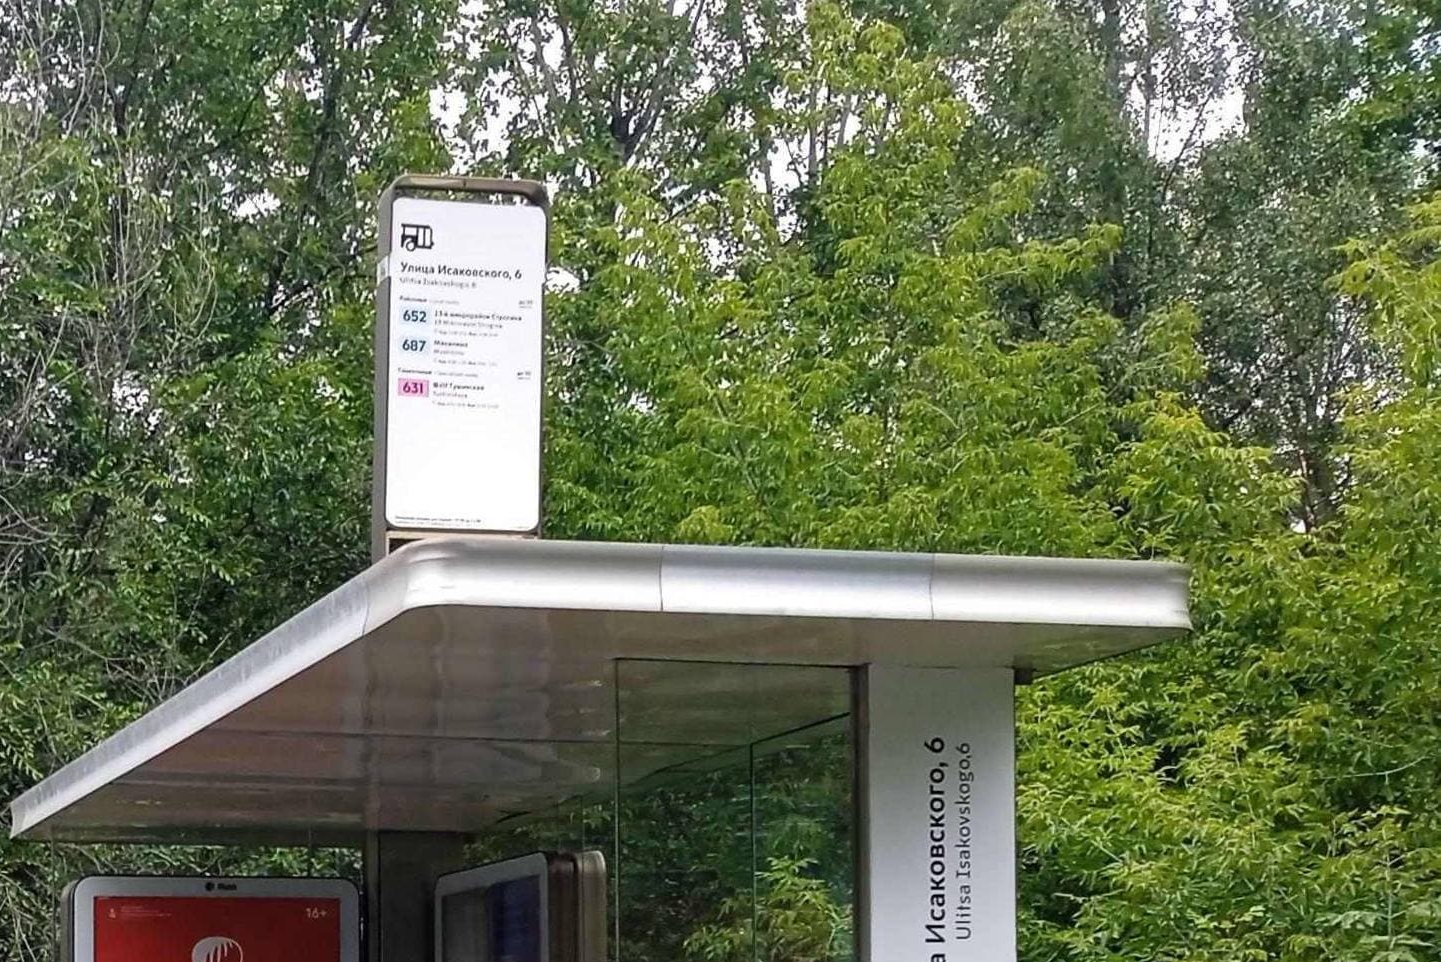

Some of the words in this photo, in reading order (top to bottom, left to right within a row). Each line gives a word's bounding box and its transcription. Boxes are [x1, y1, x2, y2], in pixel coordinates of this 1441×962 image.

[400, 262, 435, 275] Улица
[438, 265, 512, 281] Исаковского,
[514, 269, 522, 279] 6
[403, 310, 427, 323] 652
[402, 339, 427, 352] 687
[402, 380, 424, 394] 631
[924, 737, 945, 754] 6
[924, 762, 949, 943] Исаковского,
[306, 907, 328, 919] 16+
[955, 884, 971, 940] Ulitsa
